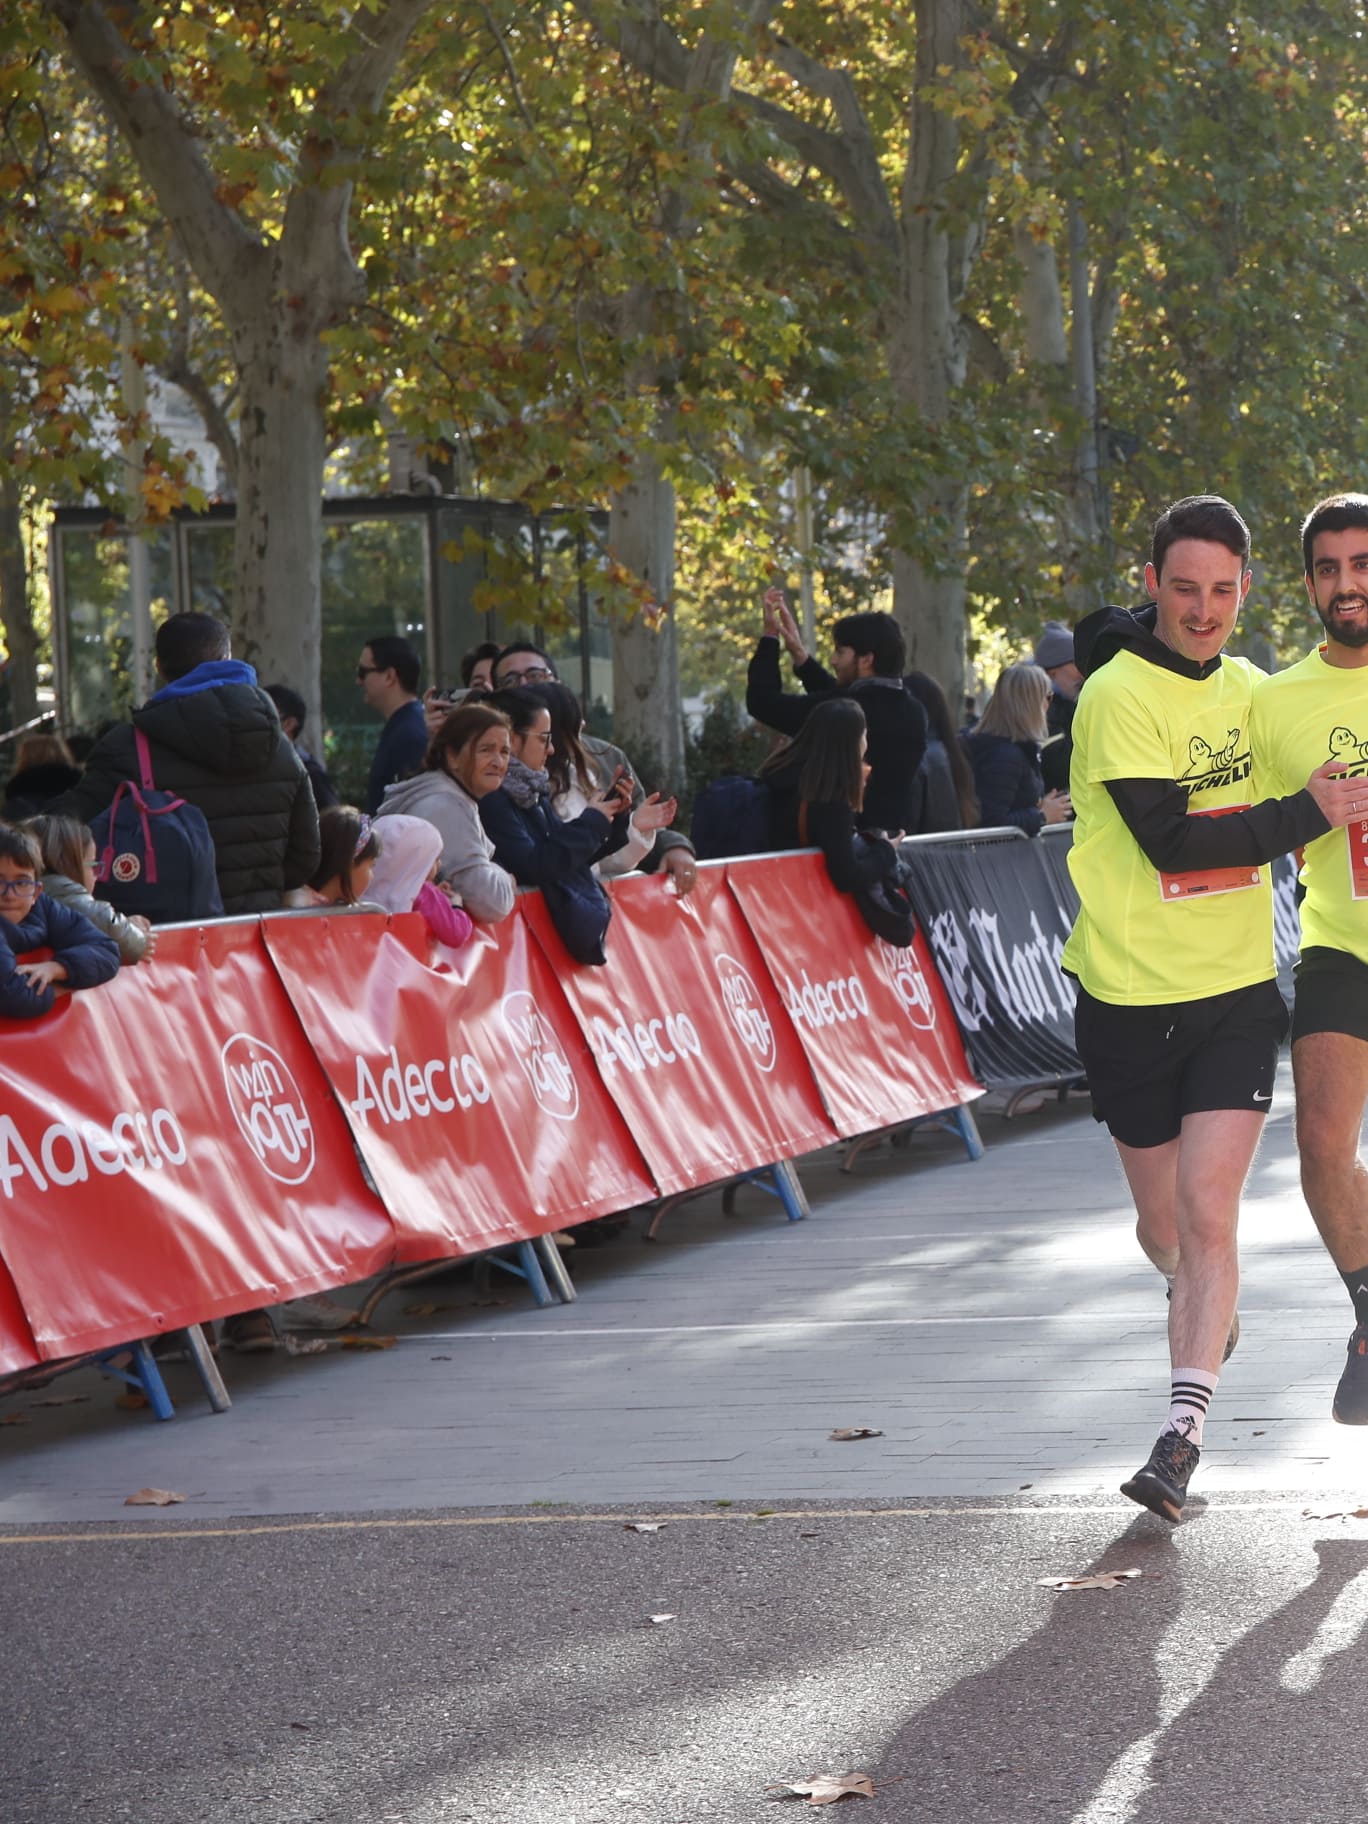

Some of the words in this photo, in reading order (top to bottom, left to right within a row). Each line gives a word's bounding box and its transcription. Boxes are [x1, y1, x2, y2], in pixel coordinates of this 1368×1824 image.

[785, 968, 869, 1029] Adecco
[593, 1007, 701, 1077] Adecco
[351, 1045, 491, 1128] Adecco
[0, 1101, 187, 1199] Adecco
